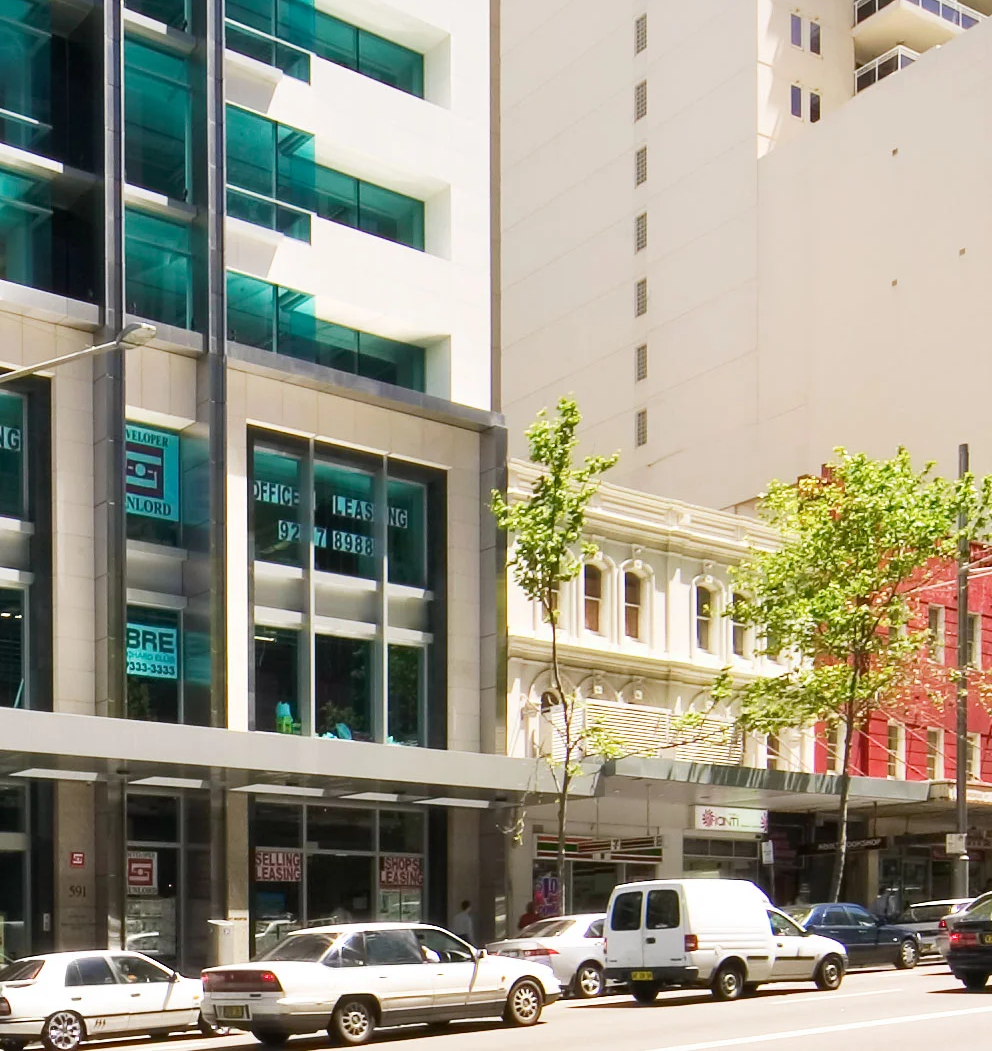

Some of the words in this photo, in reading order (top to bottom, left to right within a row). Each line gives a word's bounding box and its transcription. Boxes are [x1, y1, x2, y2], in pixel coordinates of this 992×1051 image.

[126, 430, 168, 447] VELOPER
[126, 496, 171, 516] NLORD
[335, 495, 407, 526] LEASNG
[280, 521, 325, 546] 927
[334, 532, 373, 556] 8988
[127, 628, 174, 654] BRE
[128, 662, 175, 675] 333-3333
[256, 852, 301, 867] SELLING
[385, 857, 419, 871] SHOPS
[257, 866, 301, 881] LEASING
[380, 870, 423, 885] LEASING
[69, 885, 86, 898] 591
